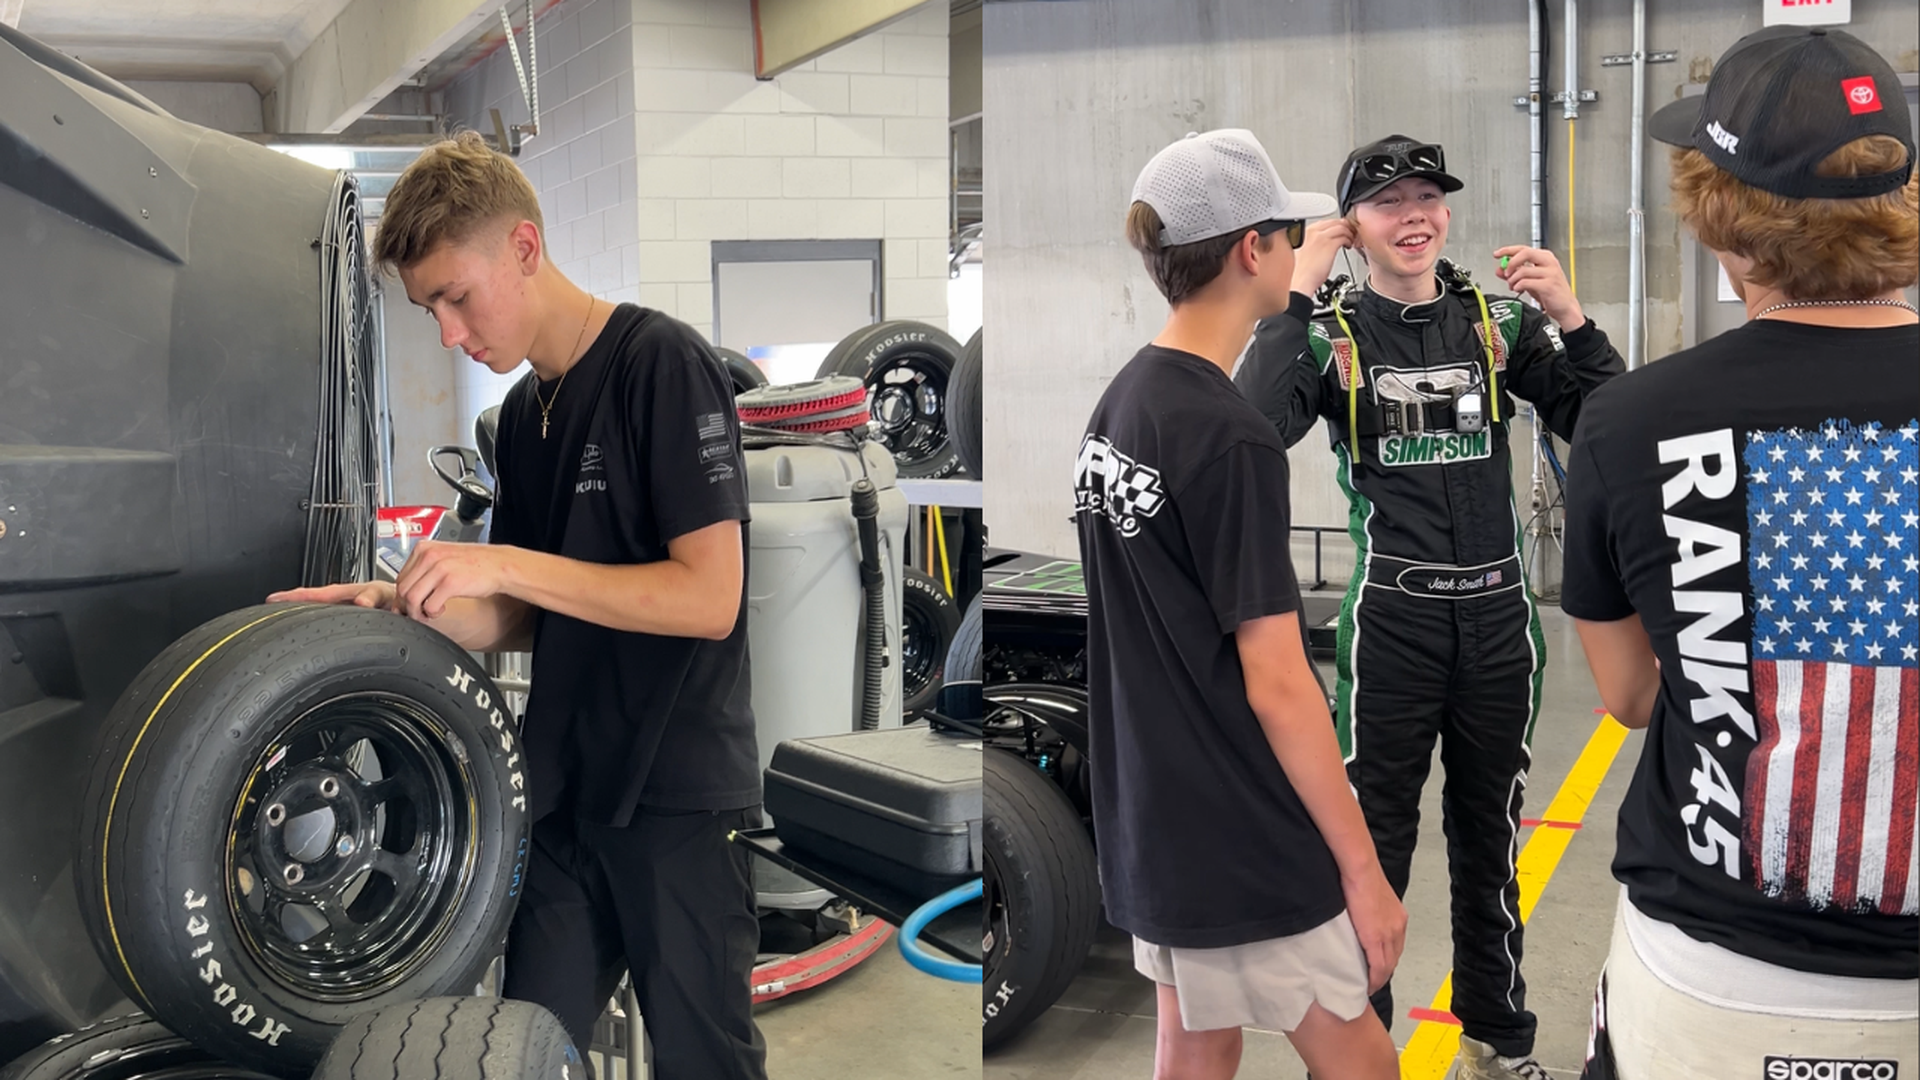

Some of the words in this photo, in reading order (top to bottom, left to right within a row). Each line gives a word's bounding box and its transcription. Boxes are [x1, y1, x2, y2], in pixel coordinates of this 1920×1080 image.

[1706, 120, 1740, 155] JGR
[864, 331, 926, 367] Hoosier
[575, 479, 607, 494] KUIU
[902, 577, 948, 607] oosier
[1427, 576, 1456, 591] Jack
[446, 663, 526, 813] Hoosier
[183, 887, 293, 1047] Hoosier
[1767, 1059, 1895, 1080] sparco
